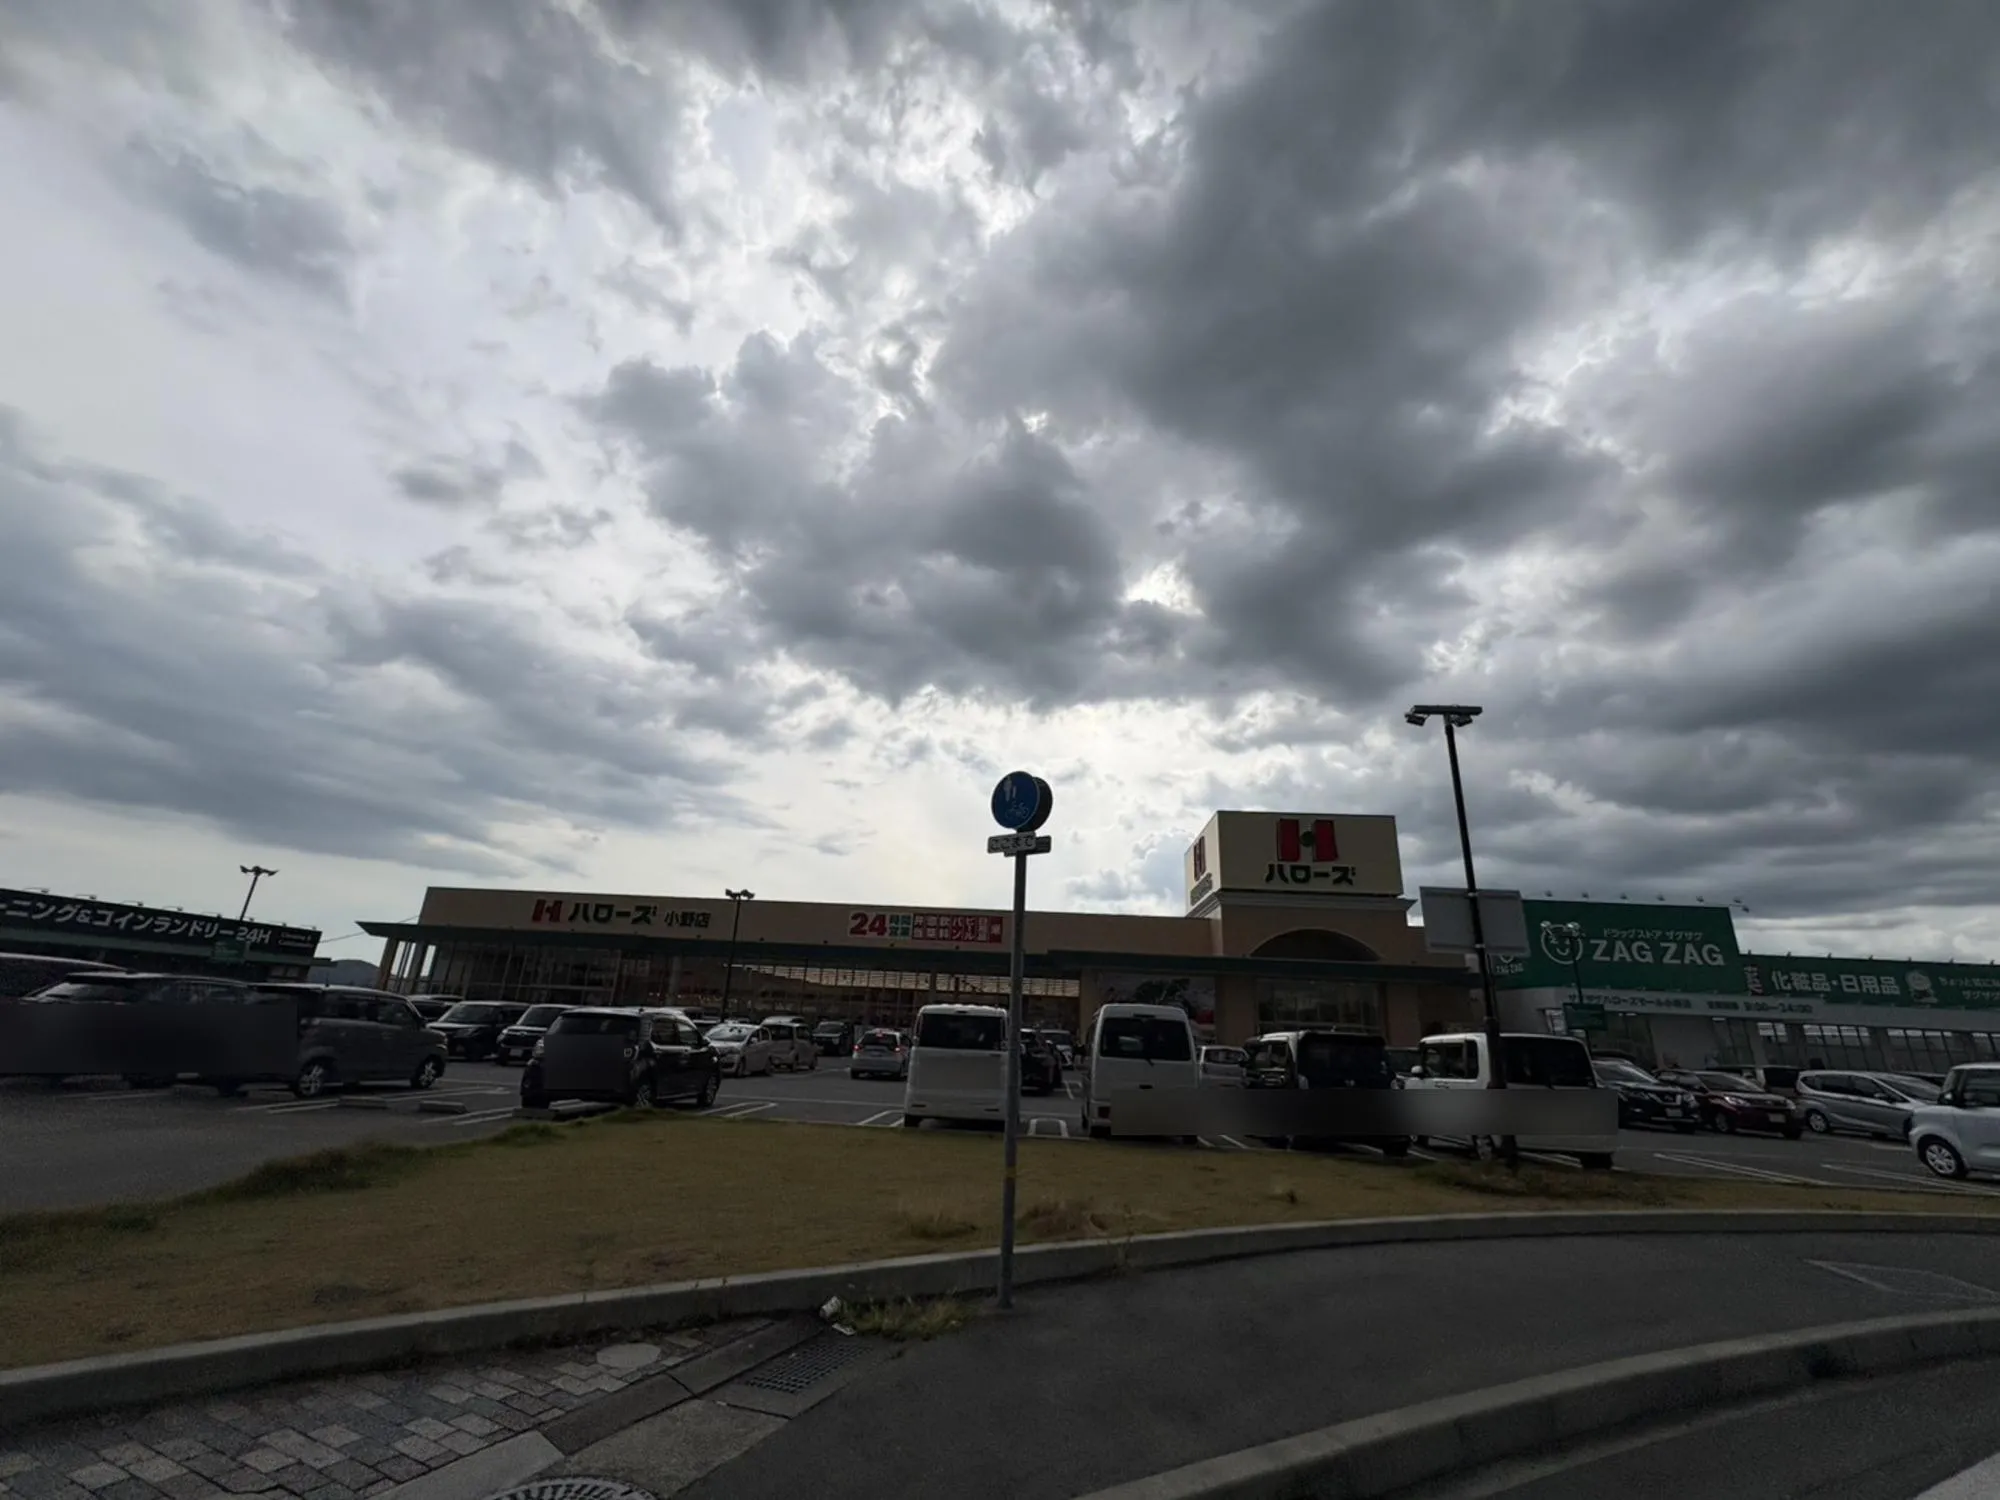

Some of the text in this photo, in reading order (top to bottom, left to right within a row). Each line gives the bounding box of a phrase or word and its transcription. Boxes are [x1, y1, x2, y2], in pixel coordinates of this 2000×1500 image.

[1265, 864, 1356, 886] ハローズ
[568, 902, 711, 929] ハローズ 小野店
[849, 912, 887, 937] 24
[1589, 938, 1726, 967] ZAG ZAG
